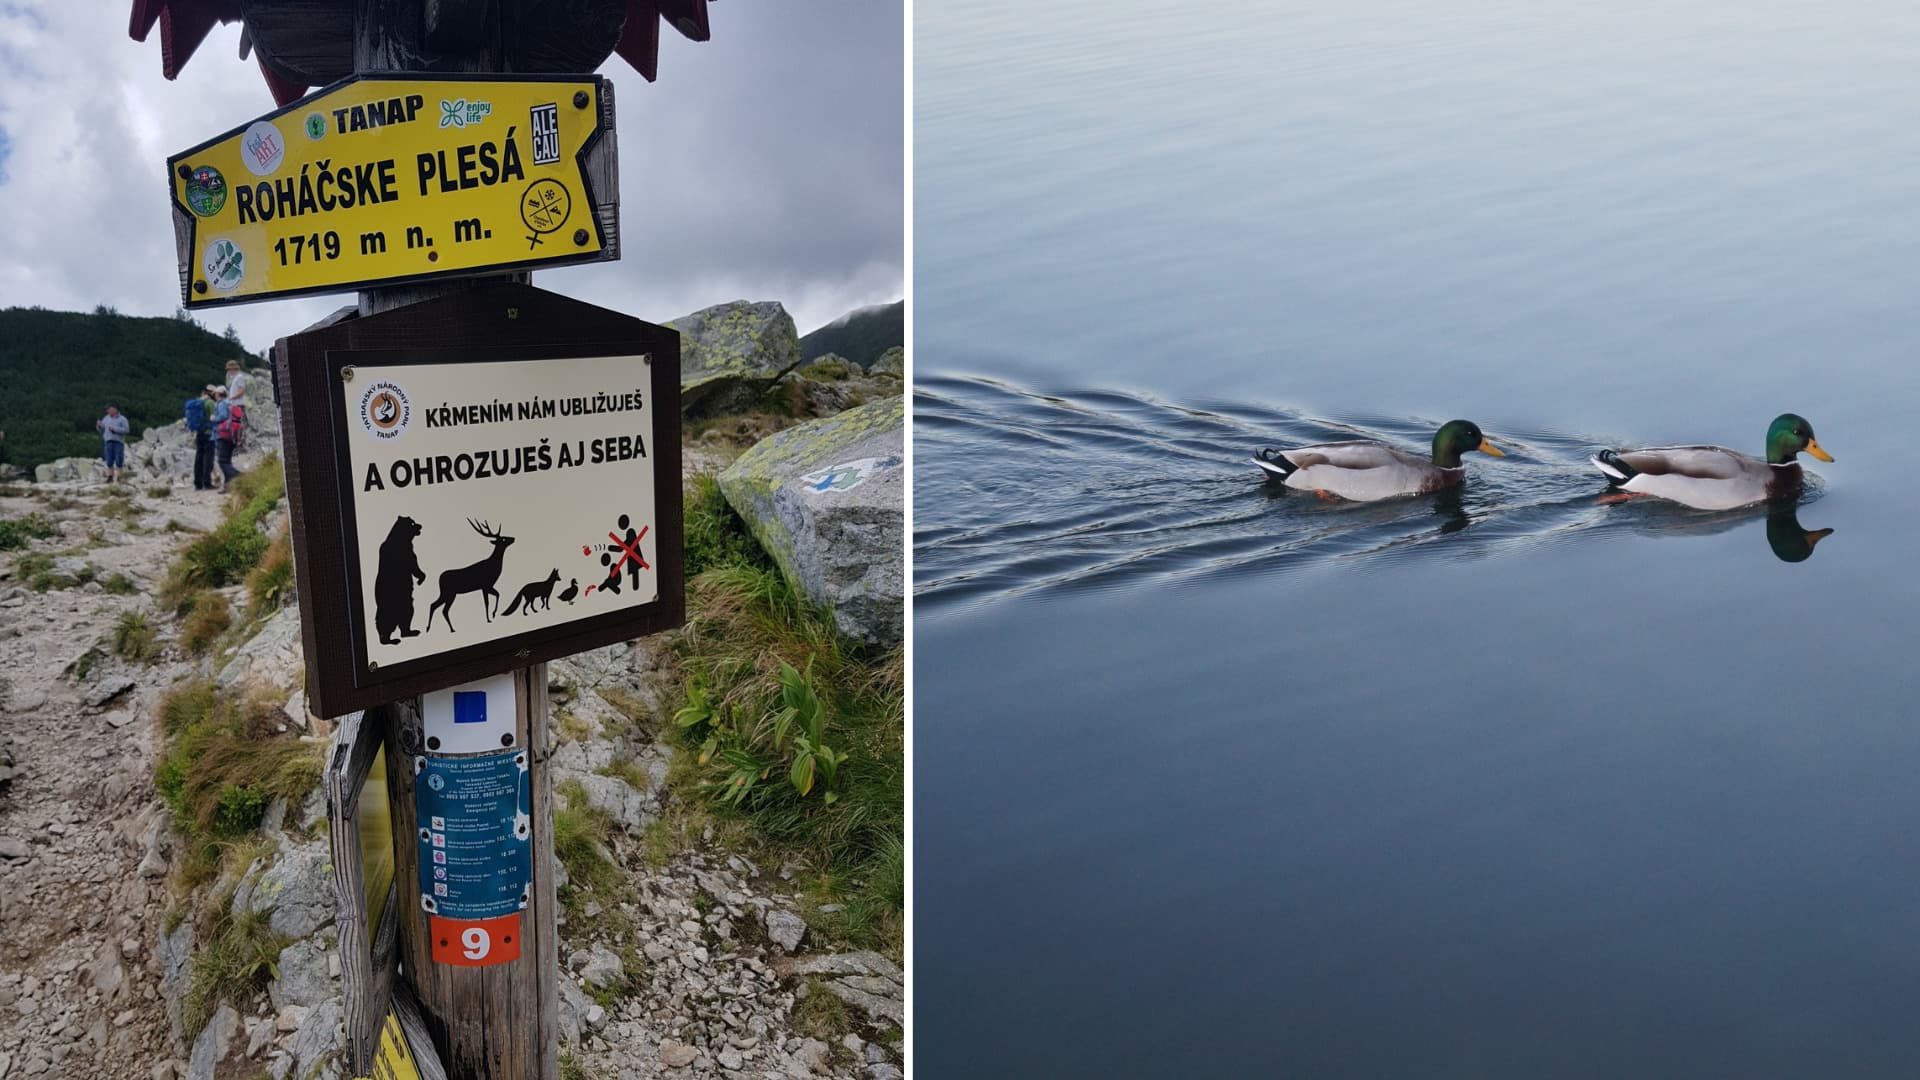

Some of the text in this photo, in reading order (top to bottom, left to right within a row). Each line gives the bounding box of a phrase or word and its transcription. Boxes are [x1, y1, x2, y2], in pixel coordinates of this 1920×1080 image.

[333, 94, 424, 134] TANAP
[466, 101, 491, 114] enjoy
[466, 112, 482, 123] life
[533, 109, 557, 137] ALE
[534, 134, 559, 161] CAU
[236, 126, 525, 225] ROHÁČSKE PLESÁ
[274, 217, 491, 266] 1719 m n. m.
[361, 380, 410, 431] TATRANSKÝ NÁRODNÝ PARK
[425, 389, 643, 428] KŔMENÍM NÁM UBLIŽUJEŠ
[376, 429, 399, 439] TANAP
[364, 434, 647, 492] A OHROZUJEŠ AJ SEBA
[461, 927, 491, 960] 9
